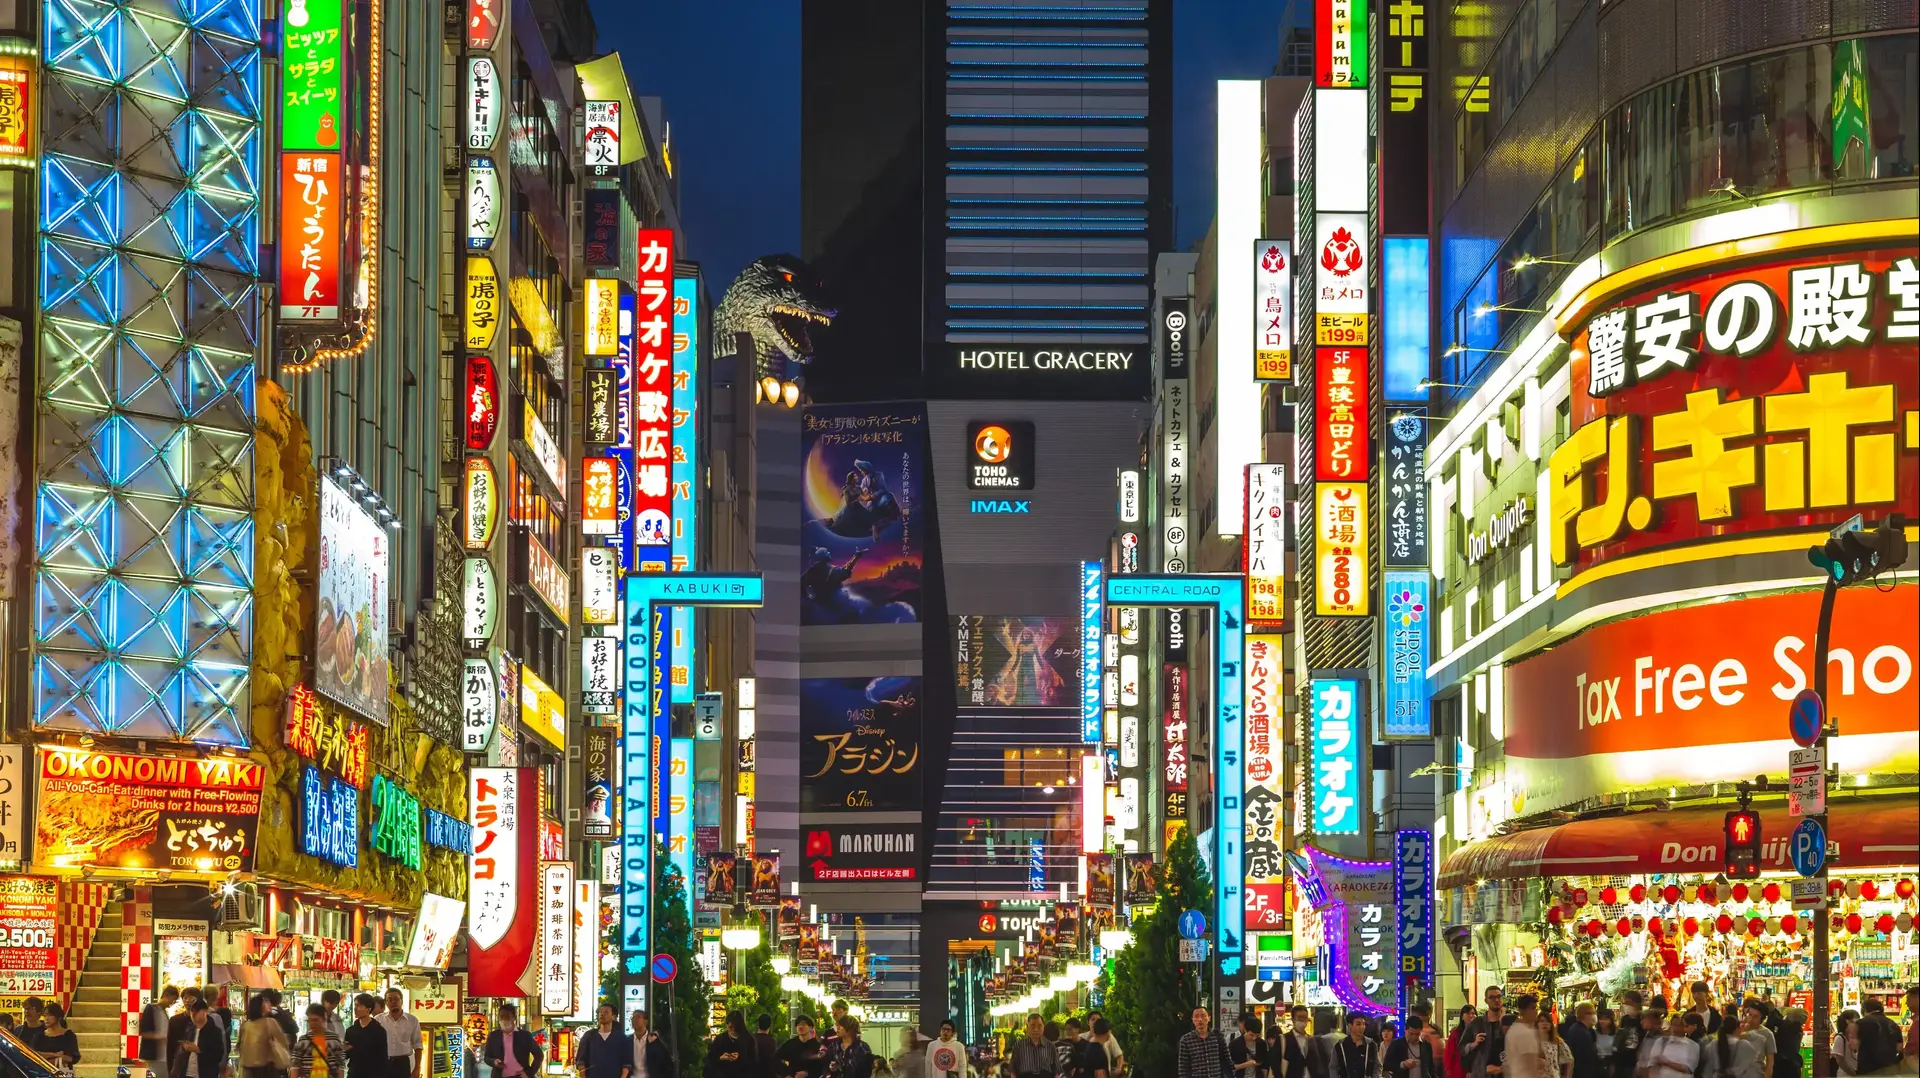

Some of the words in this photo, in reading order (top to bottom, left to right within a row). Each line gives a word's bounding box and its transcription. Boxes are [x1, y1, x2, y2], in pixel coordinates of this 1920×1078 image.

[472, 38, 490, 47] 7F
[307, 50, 318, 59] と
[288, 60, 335, 78] サラダ
[306, 79, 317, 88] と
[1323, 73, 1359, 83] ガラム
[287, 87, 337, 106] スイーツ
[588, 104, 607, 112] 海鮮
[588, 114, 616, 122] 居酒屋
[470, 134, 491, 147] 6F
[296, 158, 328, 173] 新宿
[594, 166, 608, 175] 8F
[294, 173, 329, 301] ひょうたん
[473, 239, 487, 247] 5F
[1321, 286, 1363, 300] 鳥メロ
[301, 307, 321, 318] 7F
[470, 283, 495, 328] 虎の子
[1265, 296, 1282, 346] 鳥メロ
[1321, 317, 1363, 327] 生ビール
[469, 337, 485, 345] 4F
[1166, 311, 1187, 367] Booth
[1327, 329, 1355, 342] 199
[960, 351, 1029, 369] HOTEL
[1034, 351, 1133, 369] GRACERY
[1259, 352, 1287, 360] 生ビール
[1333, 351, 1350, 364] 5F
[640, 240, 669, 497] カラオケ歌広場
[1263, 361, 1288, 372] 199
[590, 373, 611, 434] 山内農場
[804, 414, 921, 432] 美女と野獣のディズニーが
[1171, 386, 1182, 451] ネットカフェ
[1328, 366, 1356, 477] 豊後高田どり
[974, 466, 1007, 477] TOHO
[1271, 466, 1282, 475] 4F
[974, 476, 1019, 486] CINEMAS
[473, 473, 487, 540] お好み焼き
[970, 500, 1029, 513] IMAX
[1125, 480, 1135, 518] 東京ビル
[1391, 445, 1412, 558] かんかん商店
[1329, 504, 1357, 543] 酒場
[1468, 531, 1487, 566] Don
[1489, 495, 1526, 548] Quijote
[1333, 556, 1350, 605] 280
[1114, 585, 1178, 596] CENTRAL
[1183, 585, 1221, 596] ROAD
[1252, 584, 1275, 594] 198
[591, 609, 607, 620] 3F
[1252, 606, 1275, 616] 198
[469, 639, 484, 649] 1F
[1408, 630, 1420, 674] IDOL
[1394, 630, 1408, 684] STAGE
[466, 666, 487, 674] 新宿
[1085, 625, 1101, 736] カラオケランド
[1249, 640, 1270, 754] きんくら酒場
[1577, 671, 1622, 730] Tax
[1634, 655, 1748, 716] Free
[466, 676, 487, 728] かっぱ
[1395, 701, 1419, 716] 5F
[468, 734, 484, 744] B1
[590, 736, 607, 782] 海の家
[804, 733, 918, 778] アラジン
[1164, 720, 1187, 785] 甘太郎
[1319, 685, 1353, 827] カラオケ
[47, 751, 187, 784] OKONOMI
[197, 761, 261, 787] YAKI
[133, 788, 168, 798] dinner
[170, 789, 191, 799] with
[193, 790, 258, 803] Free-Flowing
[500, 771, 515, 832] 大衆酒場
[1167, 793, 1186, 803] 4F
[131, 799, 165, 810] Drinks
[167, 801, 183, 811] for
[184, 802, 190, 811] 2
[193, 802, 223, 813] hours
[226, 804, 258, 815] ¥2,500
[1167, 806, 1186, 816] 3F
[474, 778, 499, 880] トラノコ
[1245, 784, 1282, 879] 金の蔵
[839, 833, 915, 852] MARUHAN
[1660, 842, 1717, 864] Don
[1797, 833, 1811, 869] P
[227, 858, 239, 867] 2F
[1807, 851, 1818, 868] 40
[36, 895, 56, 904] YAKI
[1245, 890, 1269, 911] 2F
[1401, 837, 1426, 949] カラオケ
[158, 923, 206, 931] 防犯カメラ作動中
[1632, 918, 1643, 928] 祭
[1831, 917, 1843, 927] 祭
[1361, 904, 1385, 995] カラオケ
[1401, 955, 1425, 972] B1
[9, 979, 52, 991] 2,129円
[414, 1000, 455, 1010] トラノコ
